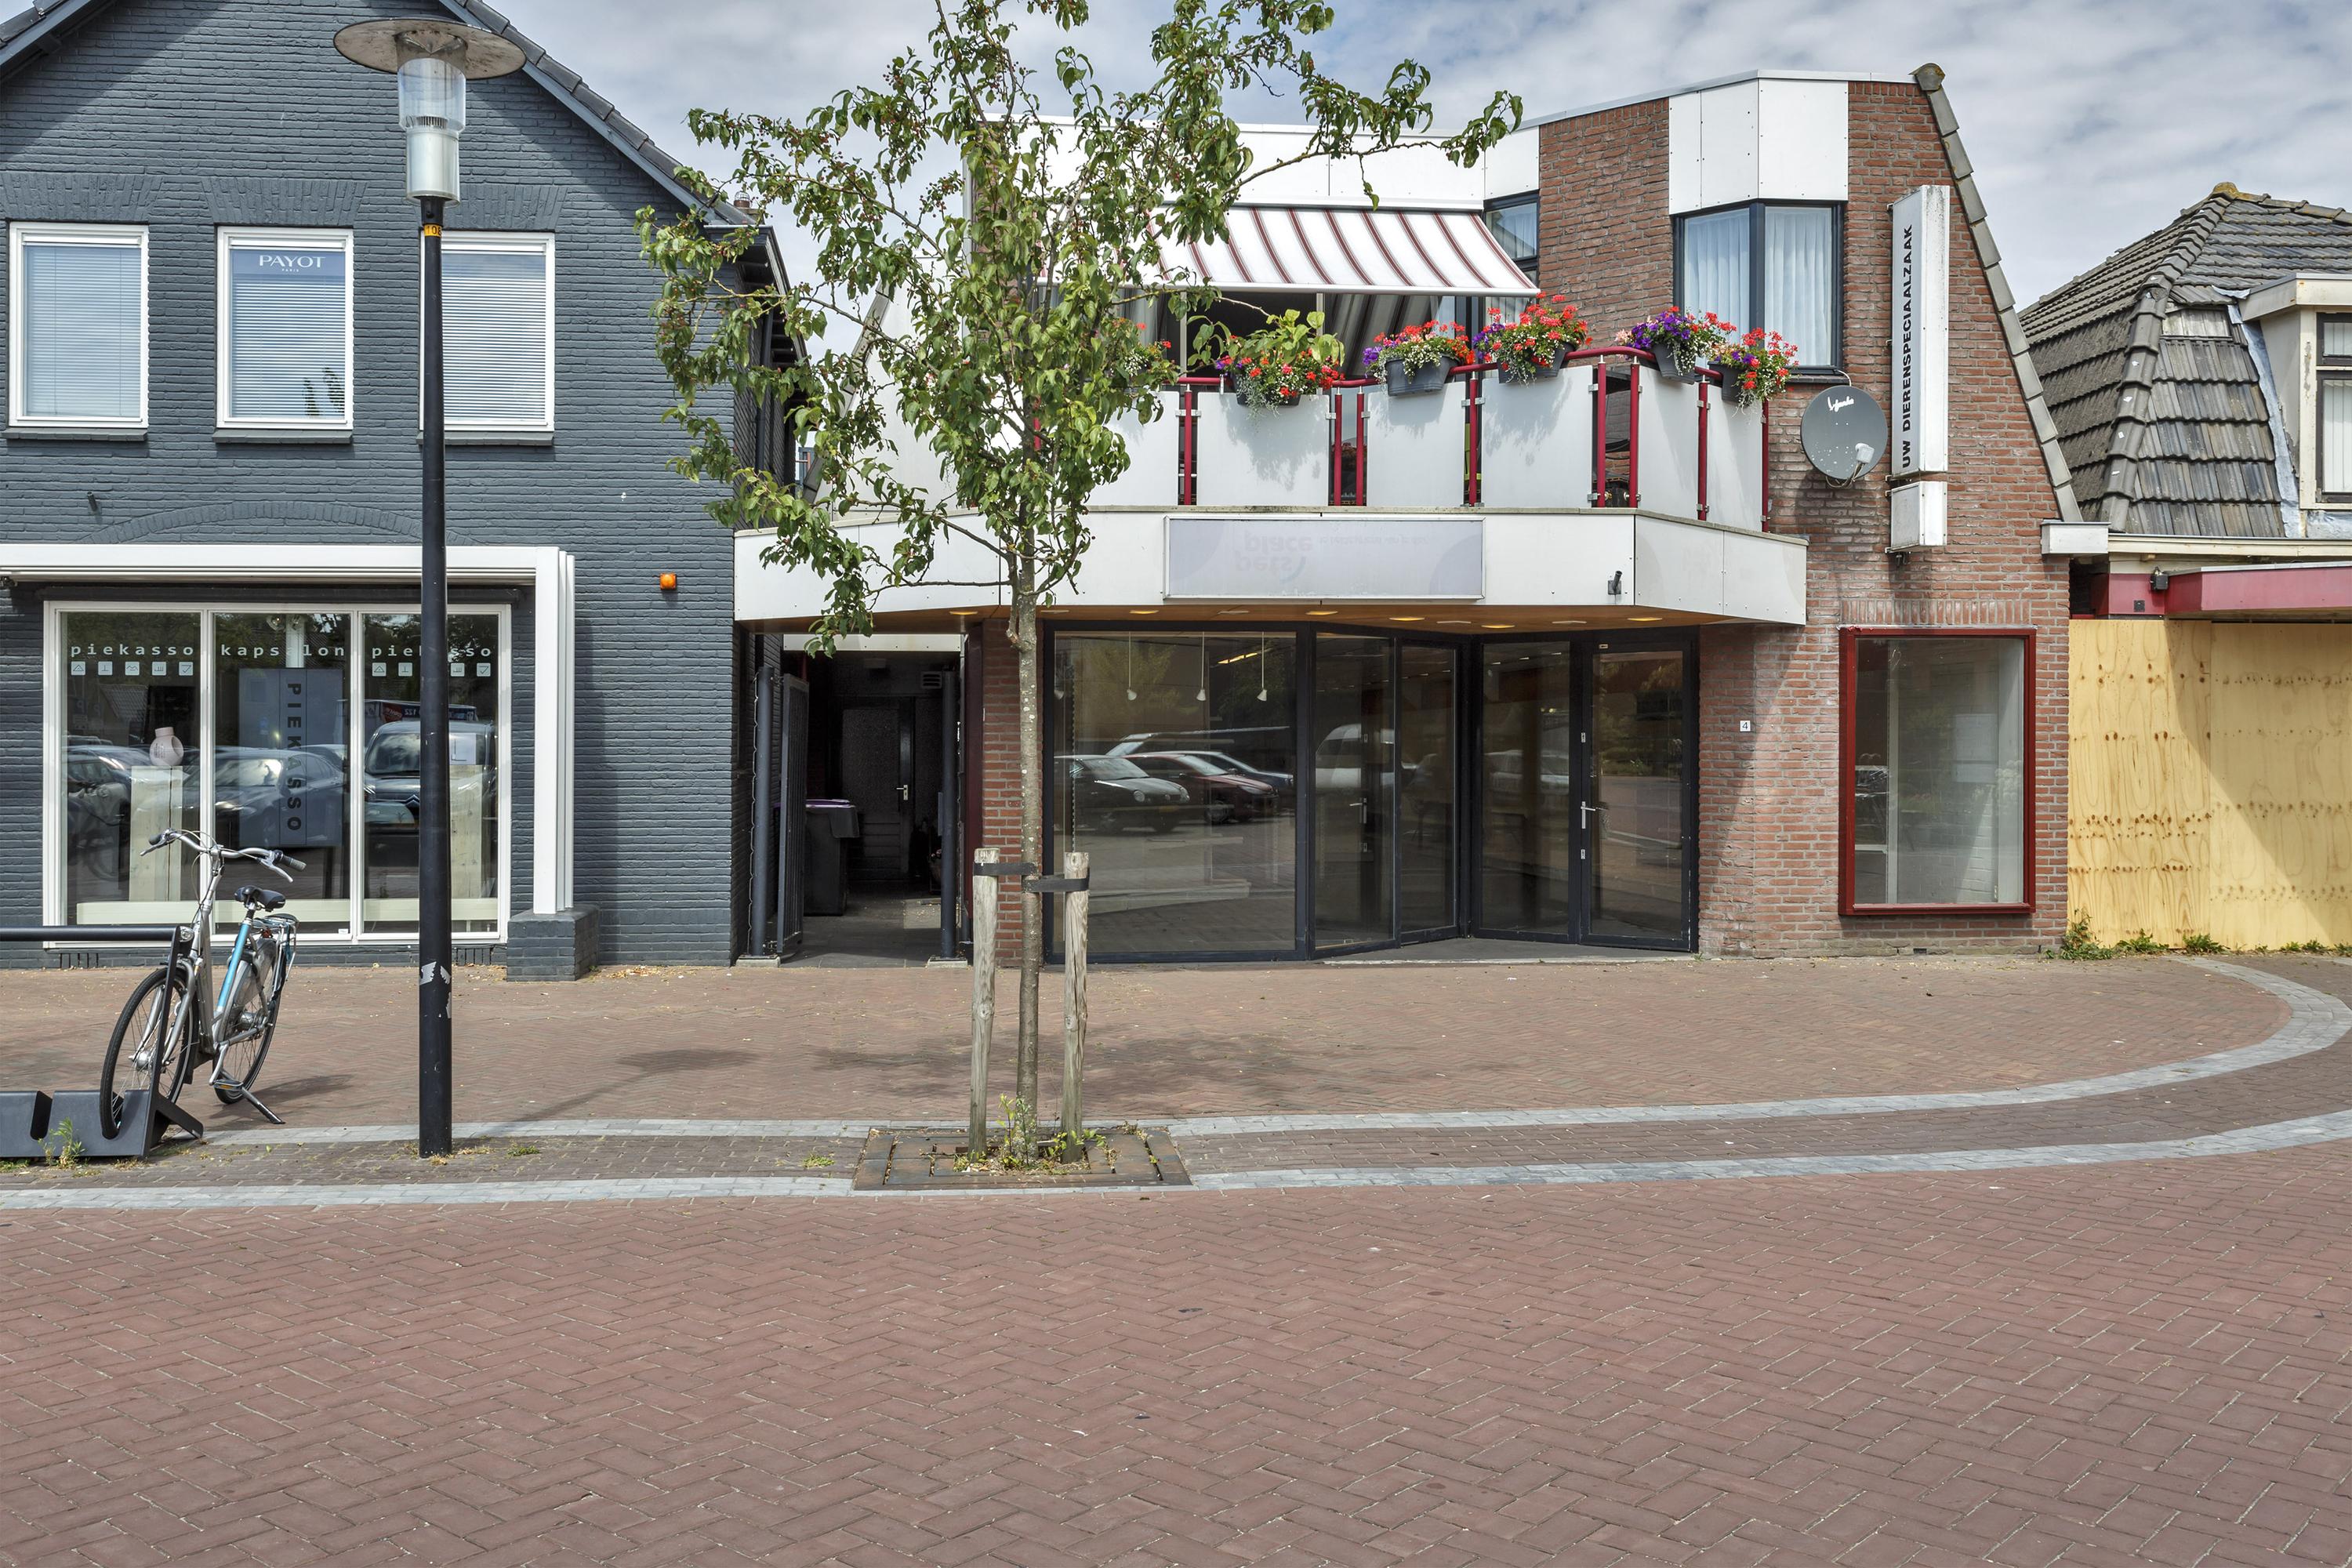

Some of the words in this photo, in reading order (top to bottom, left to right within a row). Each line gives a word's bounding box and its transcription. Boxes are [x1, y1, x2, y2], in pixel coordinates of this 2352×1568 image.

[259, 255, 326, 268] PAYOT
[1902, 224, 1913, 432] DIERENSPECIAALZAAK
[1902, 440, 1911, 469] UW
[71, 644, 194, 658] piekasso
[372, 645, 492, 659] piesso
[287, 683, 302, 831] PIEKASSO
